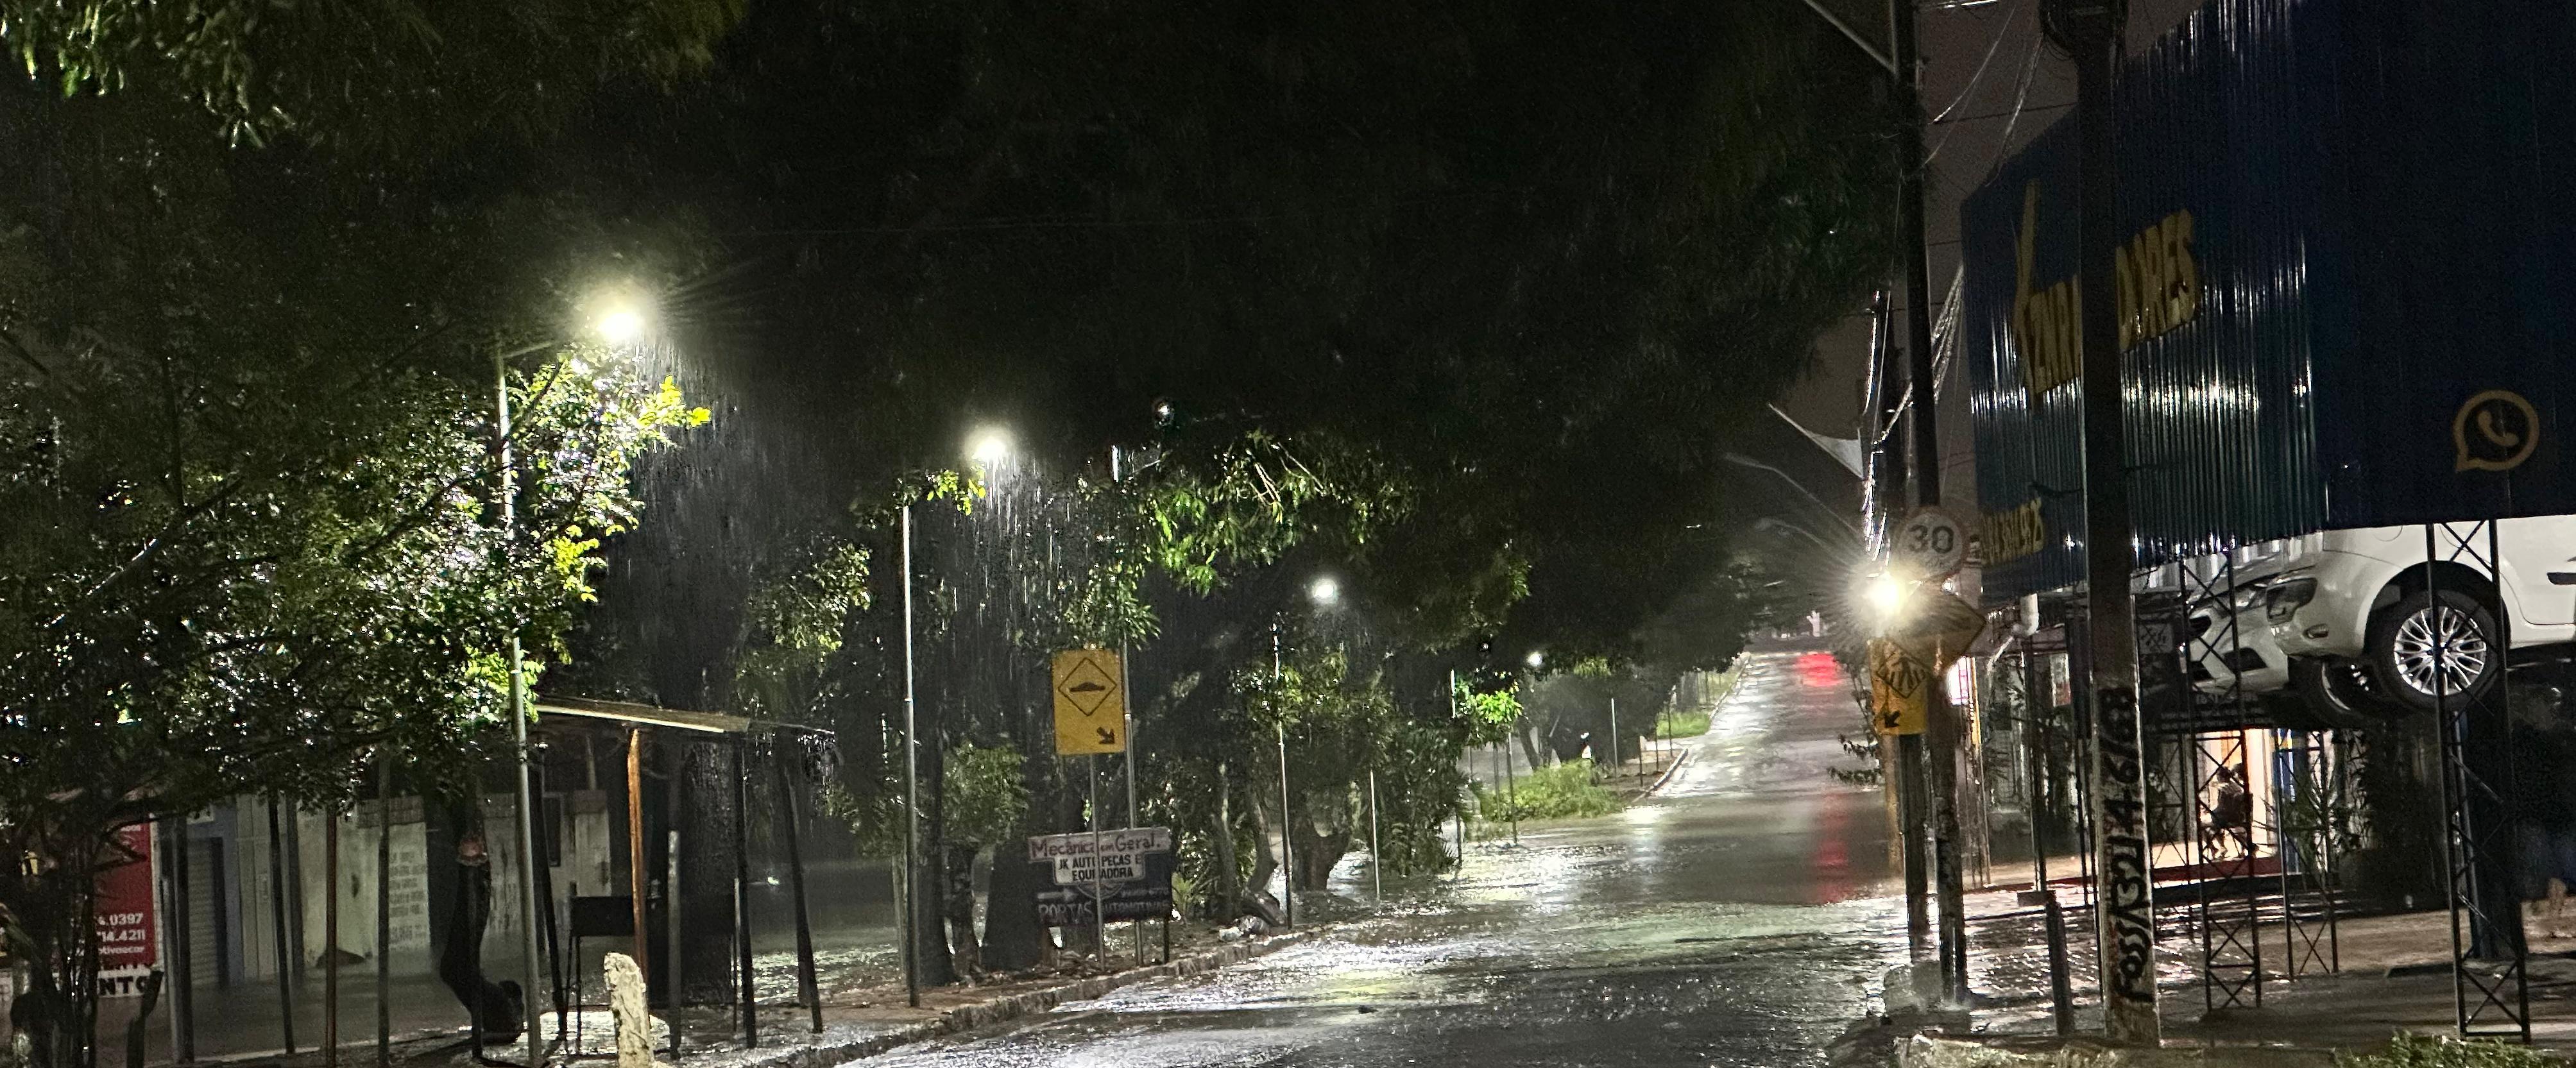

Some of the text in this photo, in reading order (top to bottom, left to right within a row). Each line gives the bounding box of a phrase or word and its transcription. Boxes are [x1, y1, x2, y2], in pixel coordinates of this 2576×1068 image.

[1909, 525, 1954, 554] 30
[1059, 859, 1069, 870] JK
[1135, 854, 1142, 865] E
